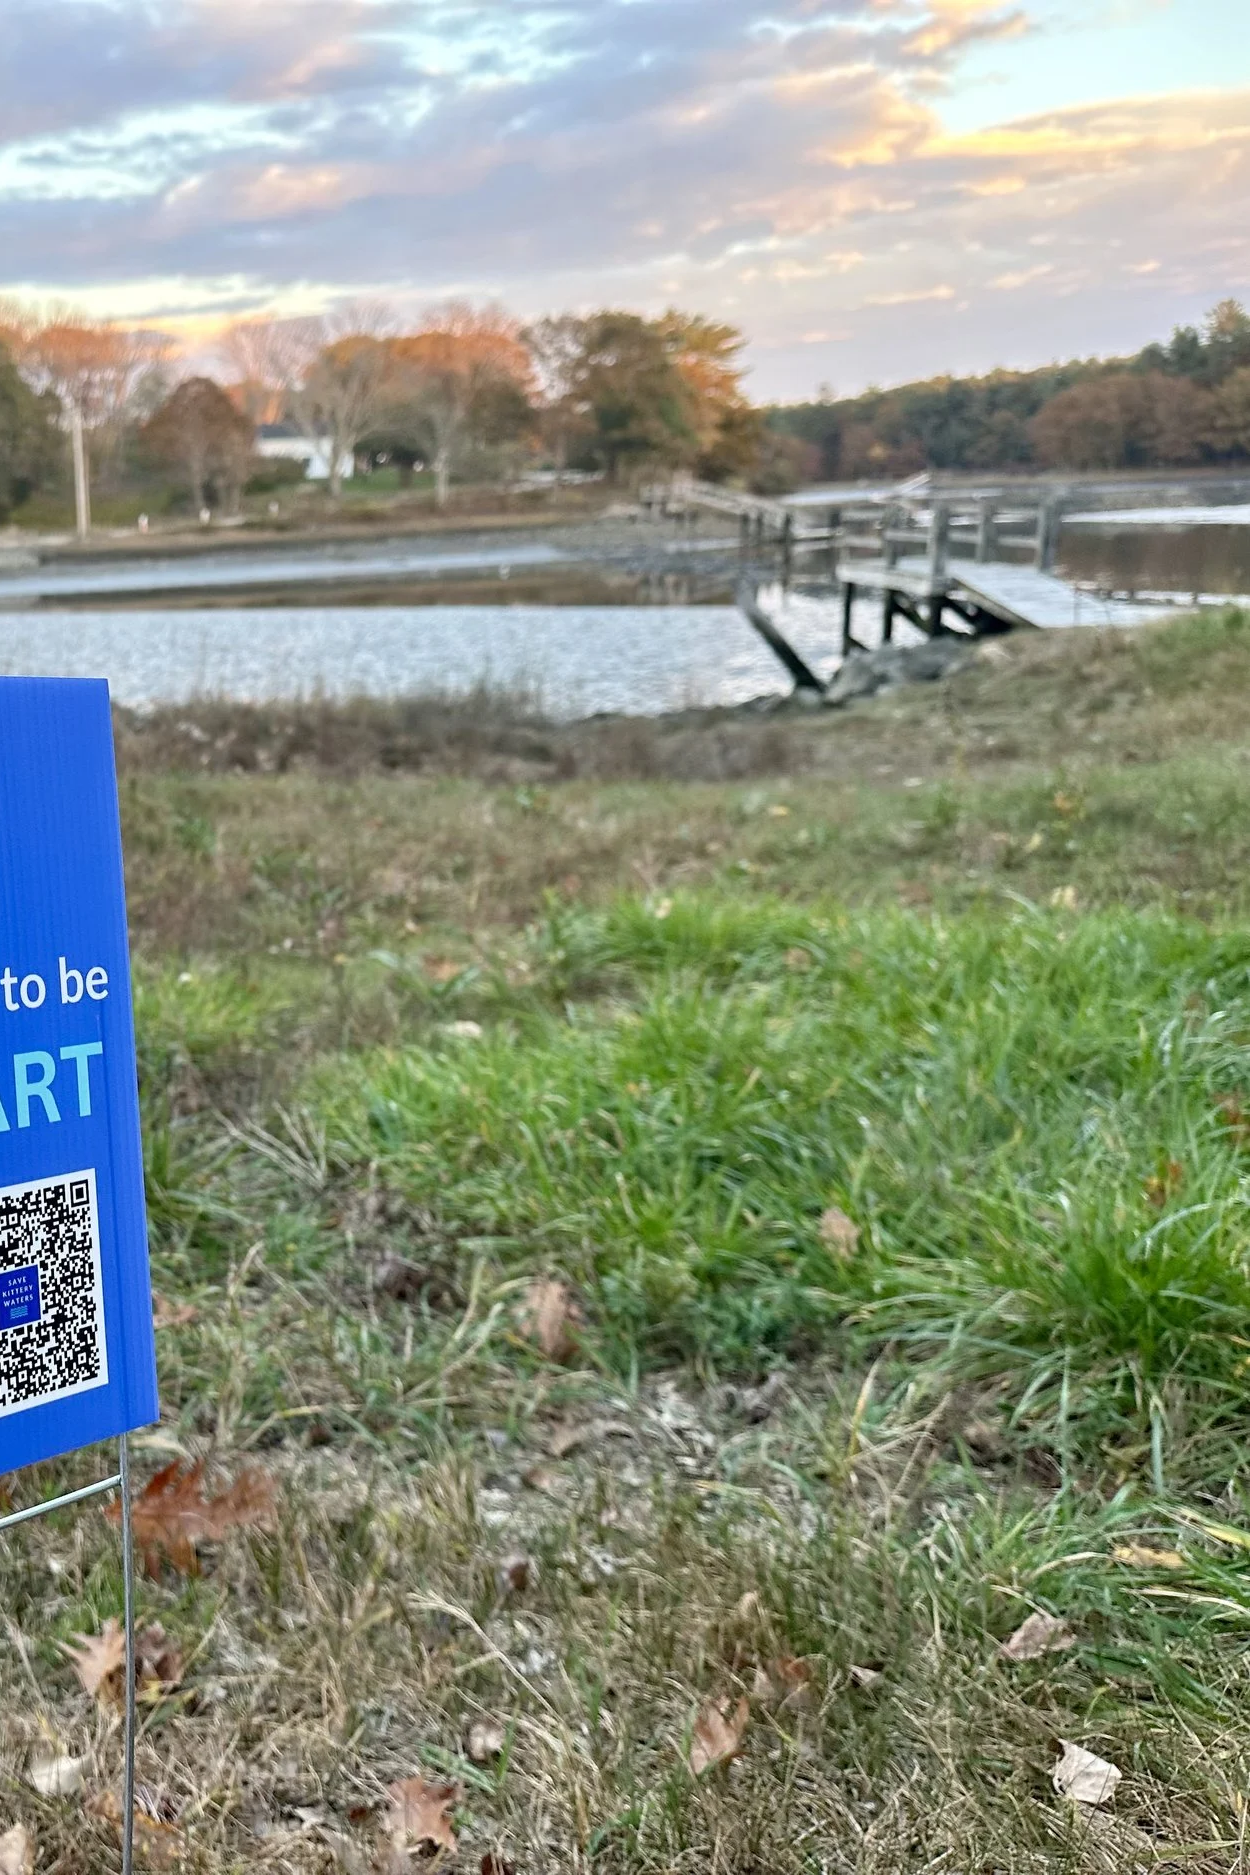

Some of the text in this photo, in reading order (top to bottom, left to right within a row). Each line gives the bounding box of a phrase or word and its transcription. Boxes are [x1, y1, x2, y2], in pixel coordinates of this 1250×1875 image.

[0, 967, 46, 1011] to
[58, 956, 109, 1004] be
[8, 1276, 27, 1287] SAVE
[2, 1284, 33, 1298] KITTERY
[3, 1293, 34, 1307] WATERS
